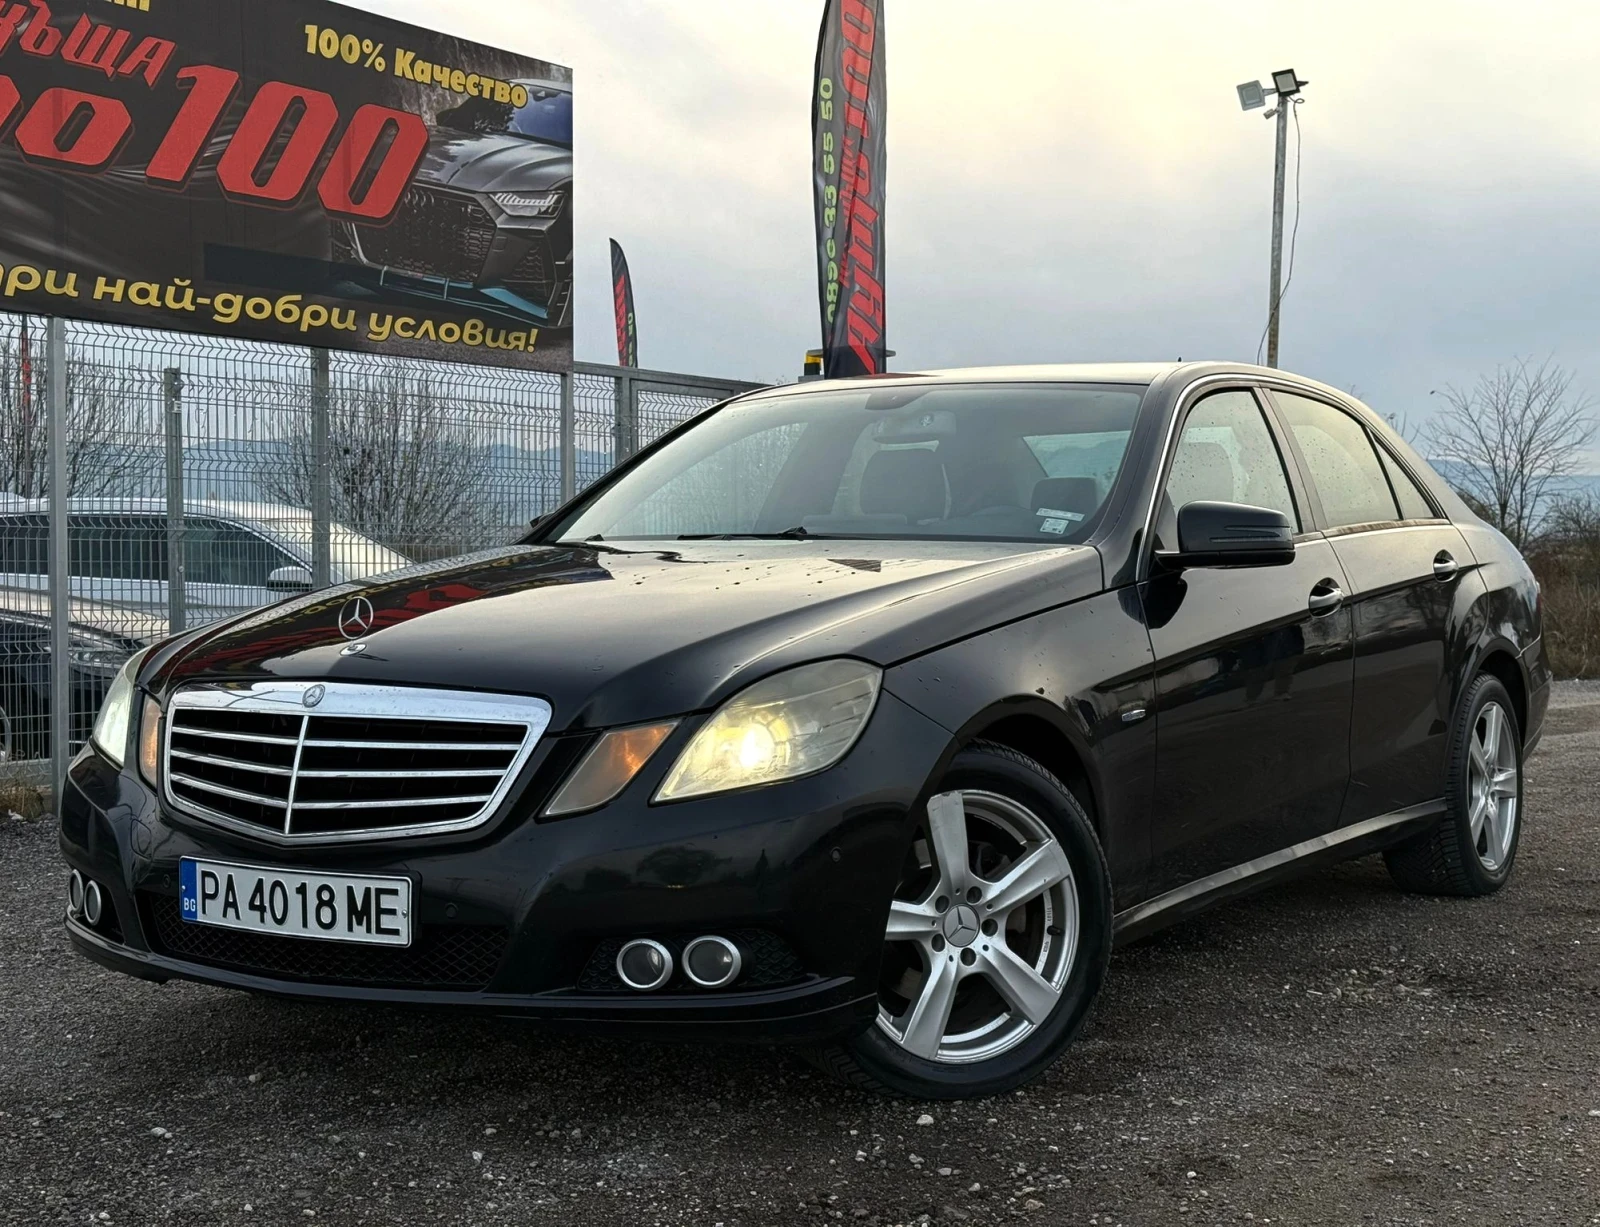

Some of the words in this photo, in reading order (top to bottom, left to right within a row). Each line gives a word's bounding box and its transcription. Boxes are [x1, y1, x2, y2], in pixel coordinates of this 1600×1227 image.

[305, 25, 386, 72] 100%
[394, 48, 528, 108] Качество
[820, 78, 833, 121] 50
[822, 132, 835, 175] 55
[824, 185, 837, 228] 33
[0, 264, 79, 297] ри
[93, 277, 357, 332] най-добри
[366, 312, 538, 352] условия!
[183, 898, 196, 911] BG
[201, 869, 242, 921] PA
[248, 877, 338, 930] 4018
[346, 885, 401, 936] ME
